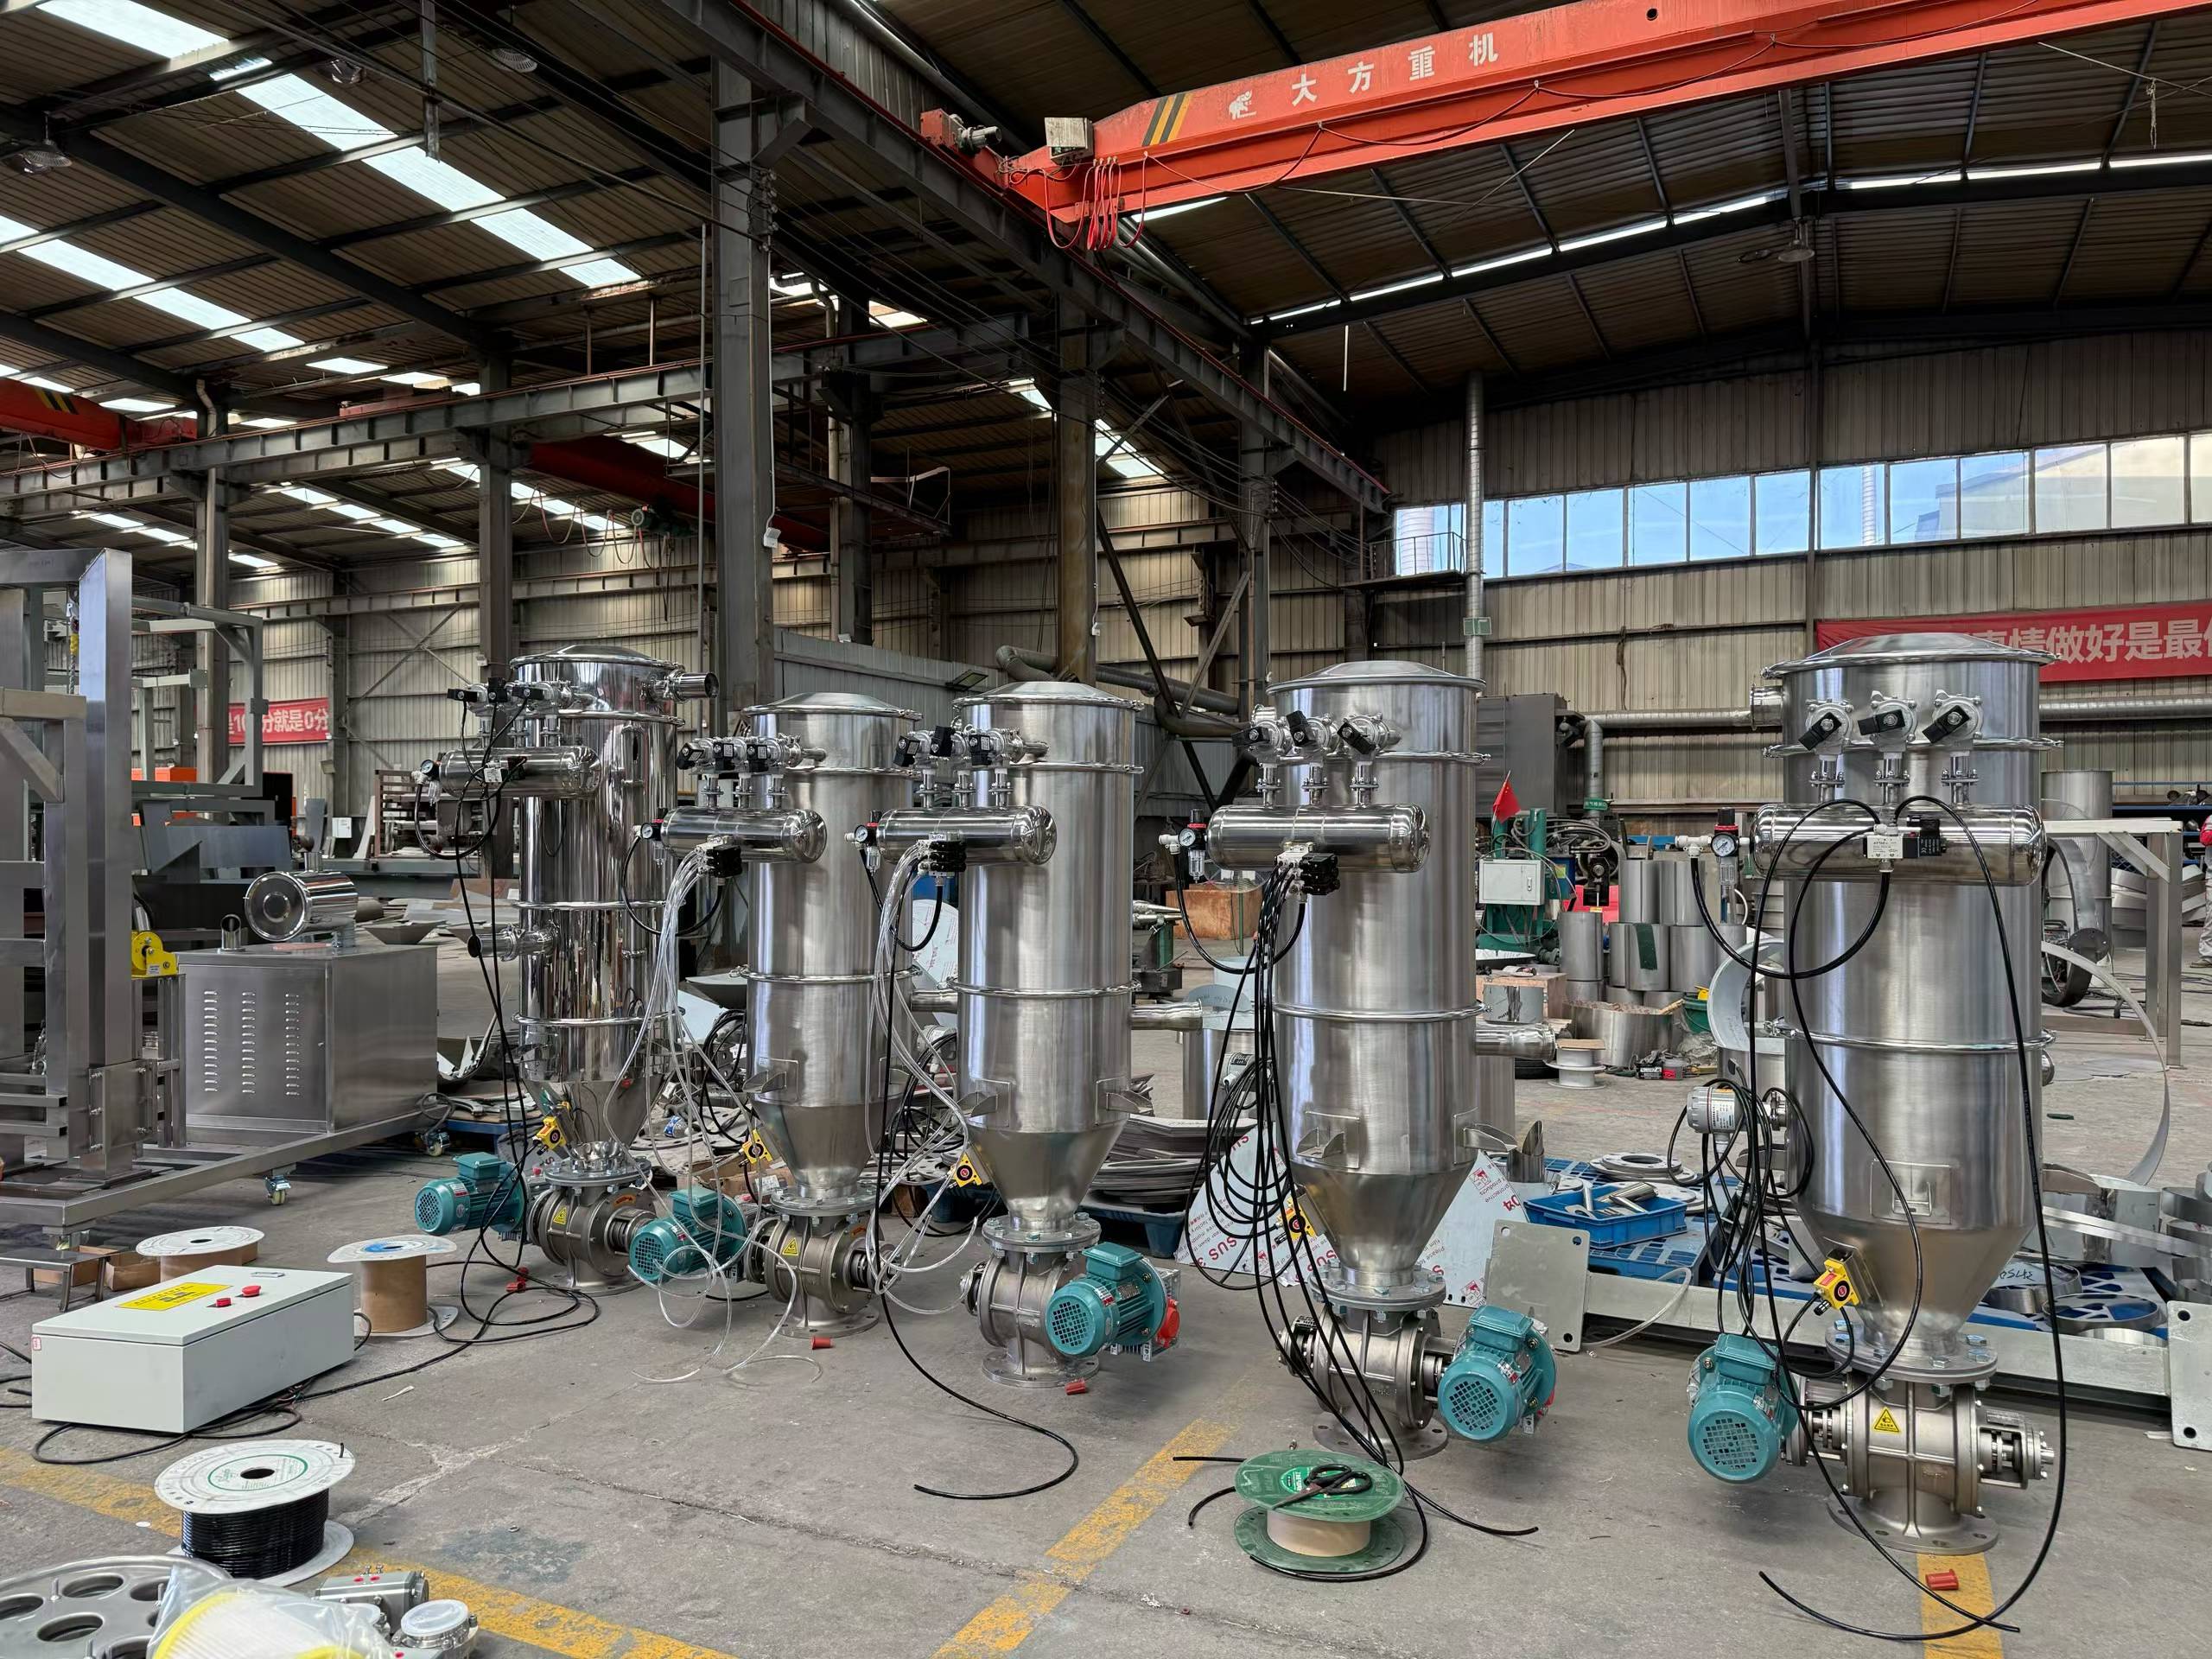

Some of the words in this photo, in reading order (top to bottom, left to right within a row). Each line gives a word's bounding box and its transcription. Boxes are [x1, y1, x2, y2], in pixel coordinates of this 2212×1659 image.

[1292, 32, 1498, 106] 大方重机
[1209, 1236, 1236, 1261] SUS
